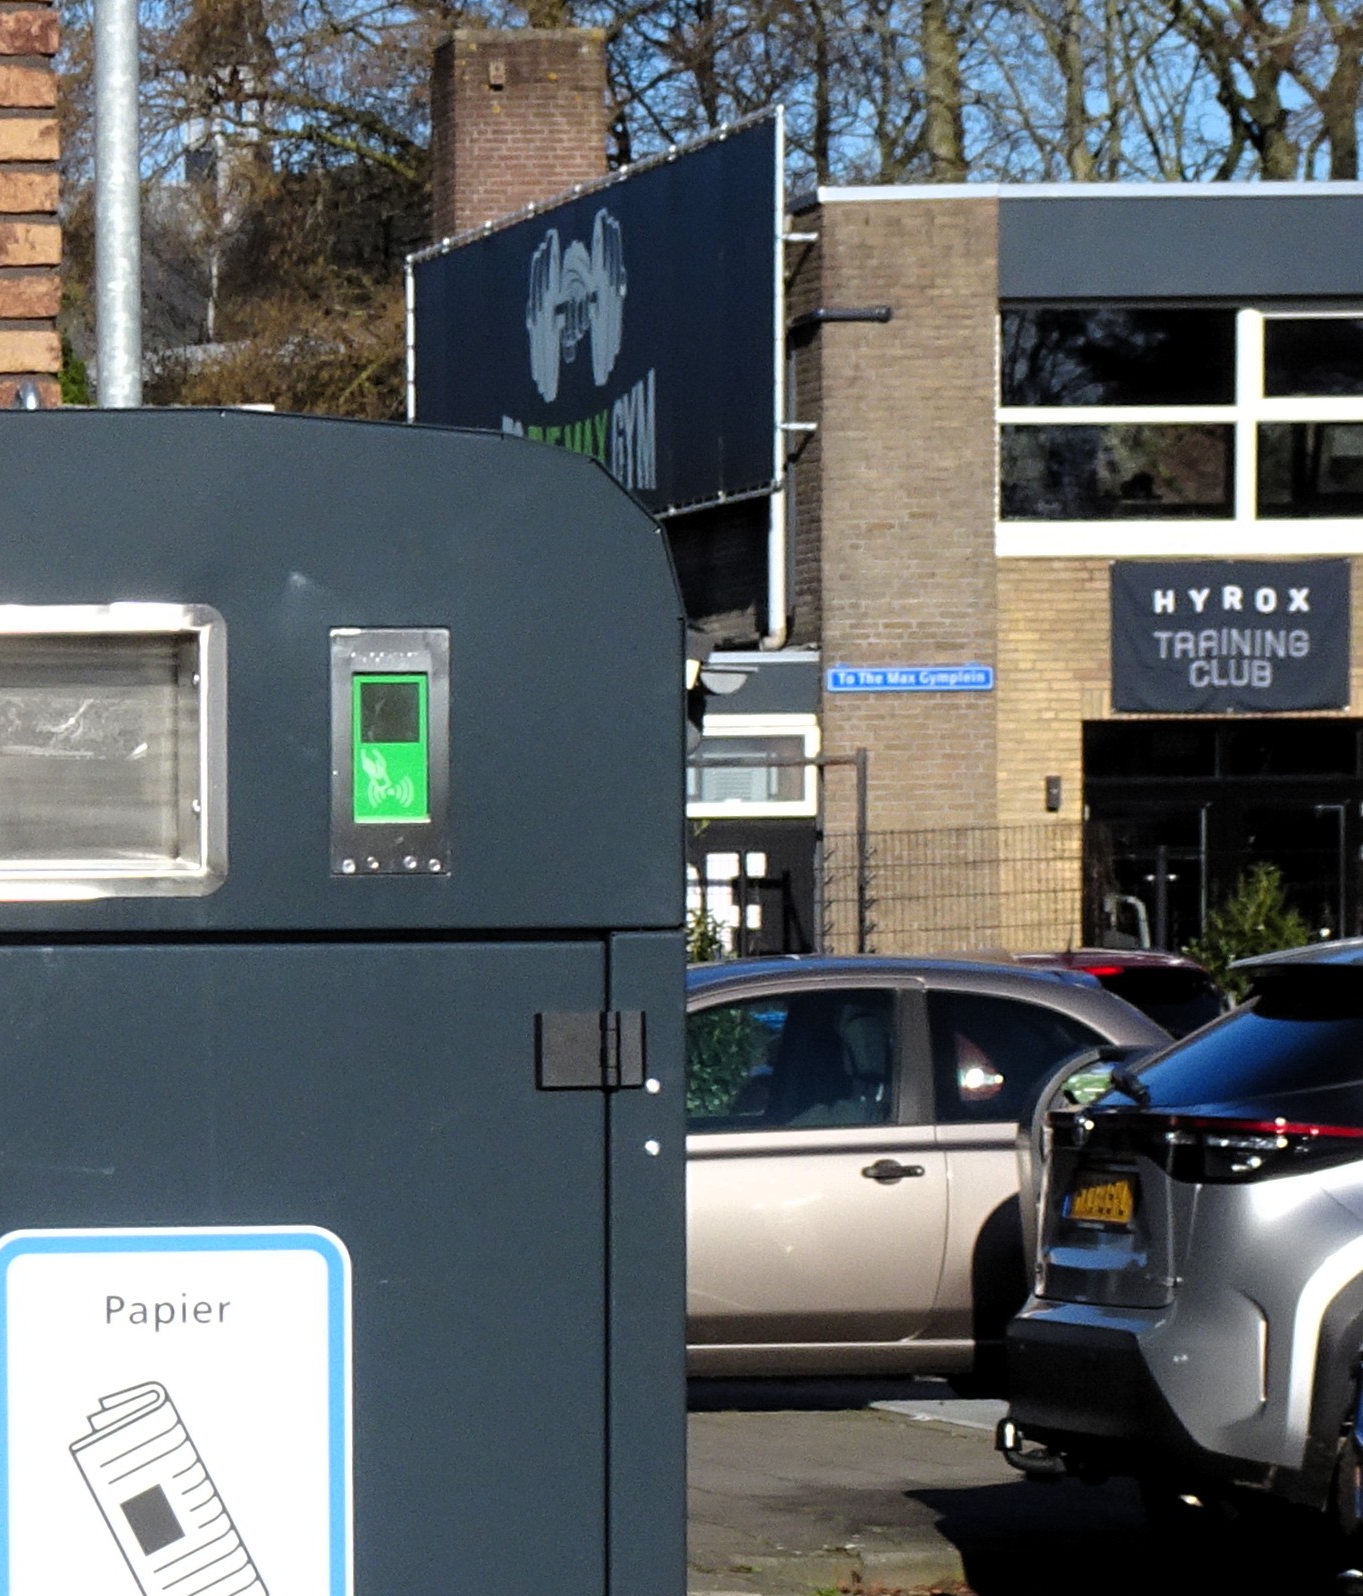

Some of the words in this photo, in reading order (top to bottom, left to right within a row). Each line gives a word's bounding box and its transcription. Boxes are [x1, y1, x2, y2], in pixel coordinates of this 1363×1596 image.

[1152, 584, 1310, 614] HYROX
[1152, 628, 1311, 659] TRAINING
[838, 672, 856, 685] To
[859, 672, 883, 684] The
[886, 671, 916, 684] Max
[918, 671, 985, 686] Gymplein
[1188, 658, 1273, 688] CLUB
[105, 1292, 231, 1332] Papier
